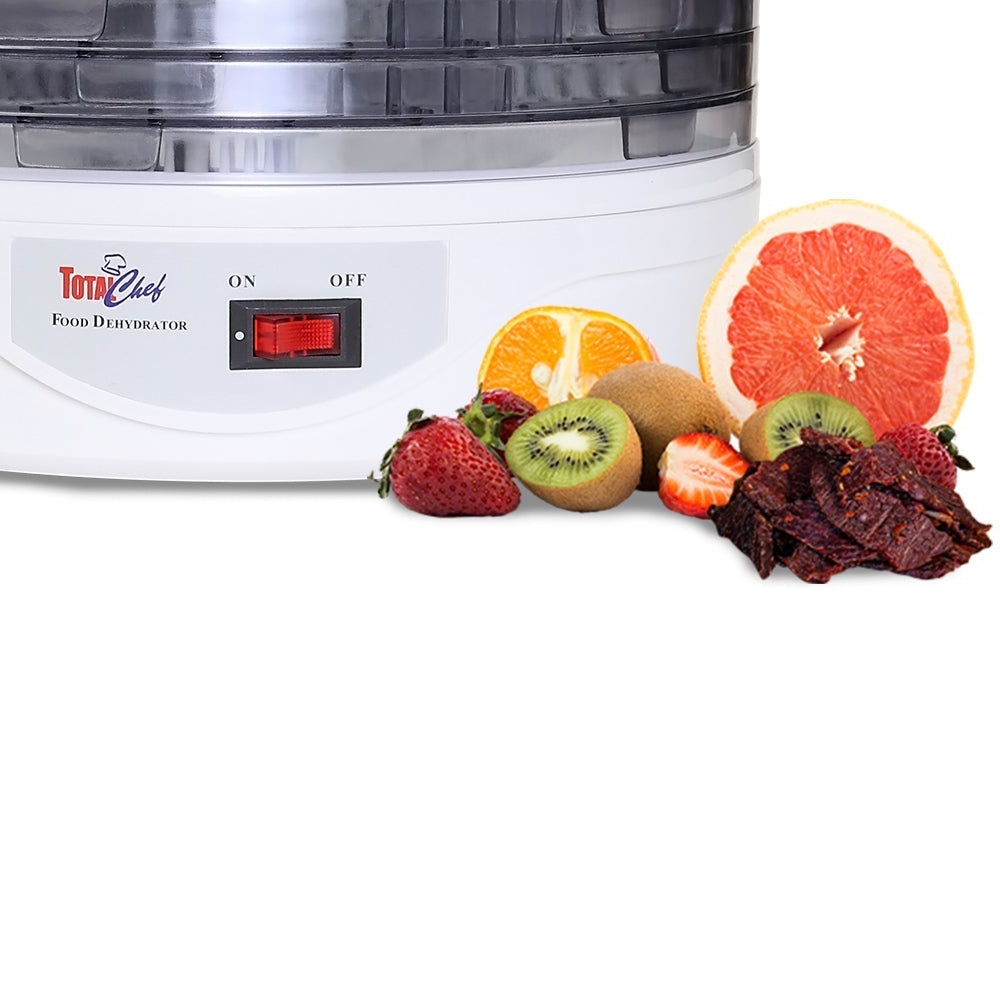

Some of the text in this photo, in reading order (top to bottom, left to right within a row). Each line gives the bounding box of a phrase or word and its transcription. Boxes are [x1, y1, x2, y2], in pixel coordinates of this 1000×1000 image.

[104, 268, 167, 307] Chef
[228, 274, 256, 289] ON
[329, 273, 367, 288] OFF
[52, 312, 188, 331] FOOD DEHYDRATOR
